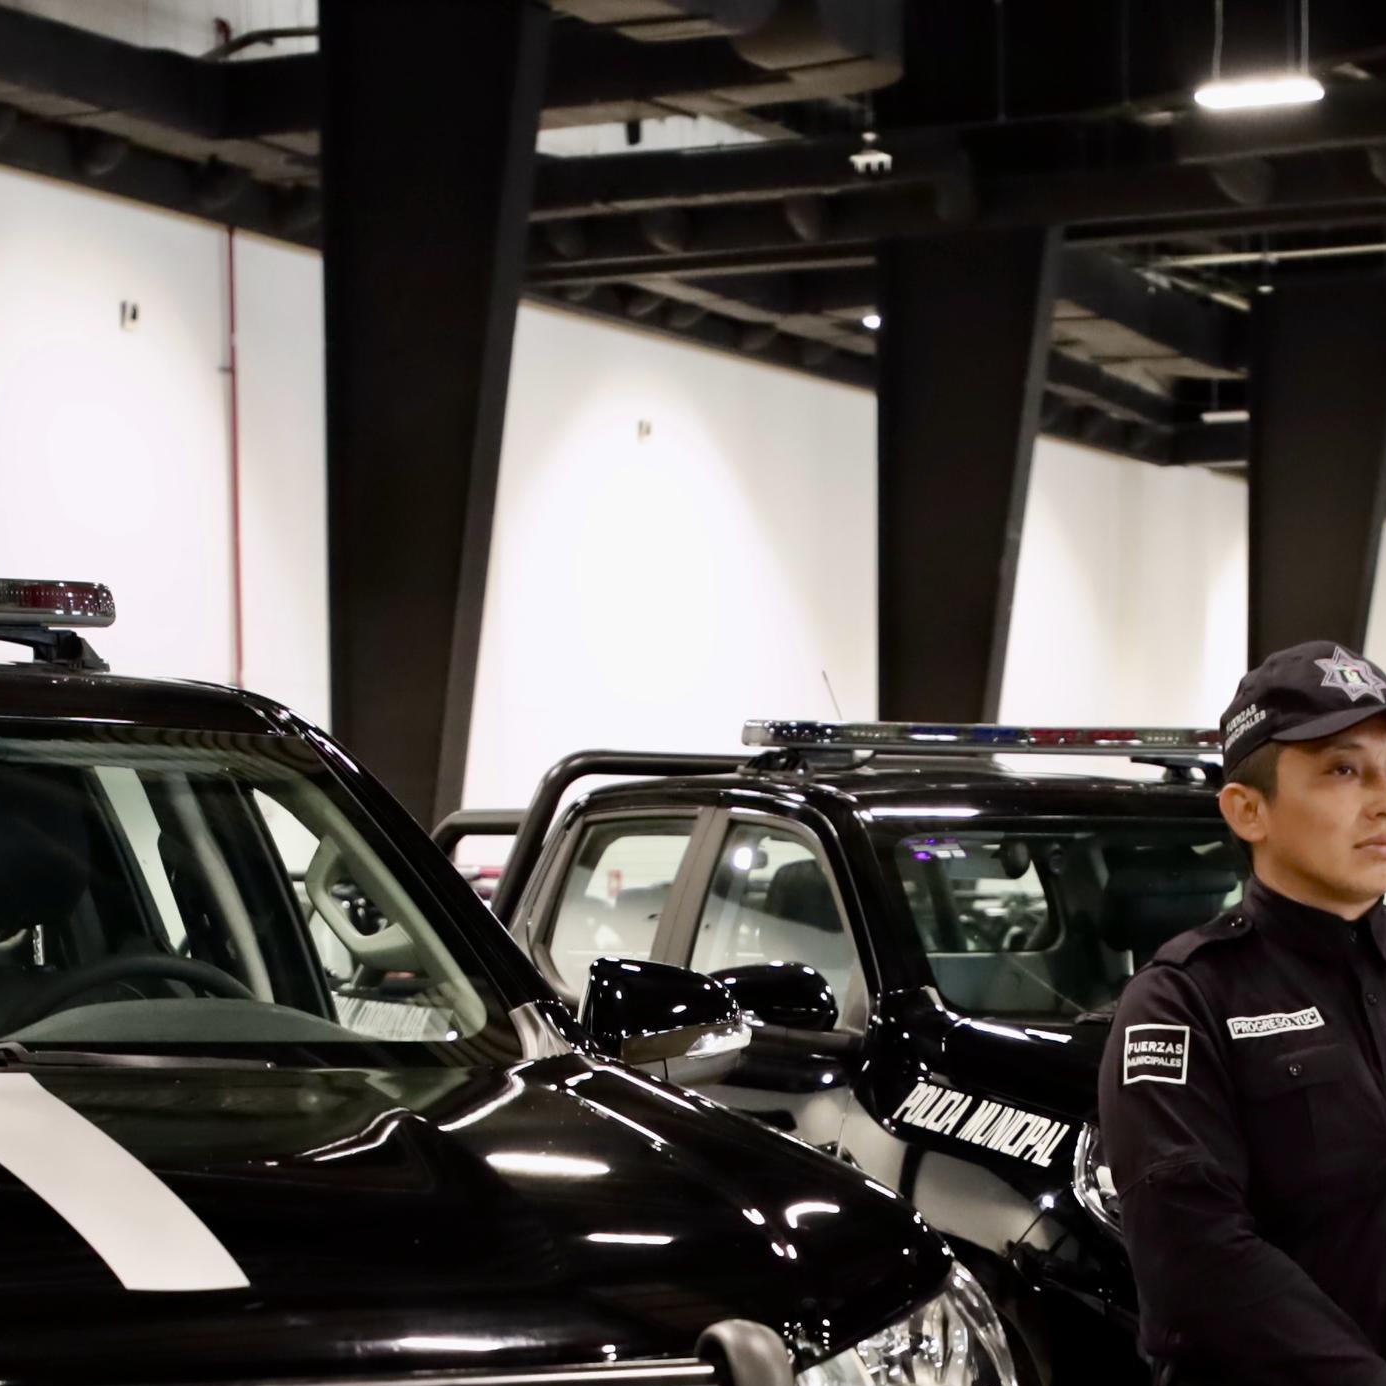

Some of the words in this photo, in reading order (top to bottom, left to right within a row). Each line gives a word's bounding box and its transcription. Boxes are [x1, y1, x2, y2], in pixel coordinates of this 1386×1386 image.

[1128, 1041, 1183, 1055] FUERZAS
[1128, 1056, 1182, 1068] MUNICIPALES
[891, 1082, 973, 1135] POLICIA
[955, 1100, 1070, 1168] MUNICIPAL
